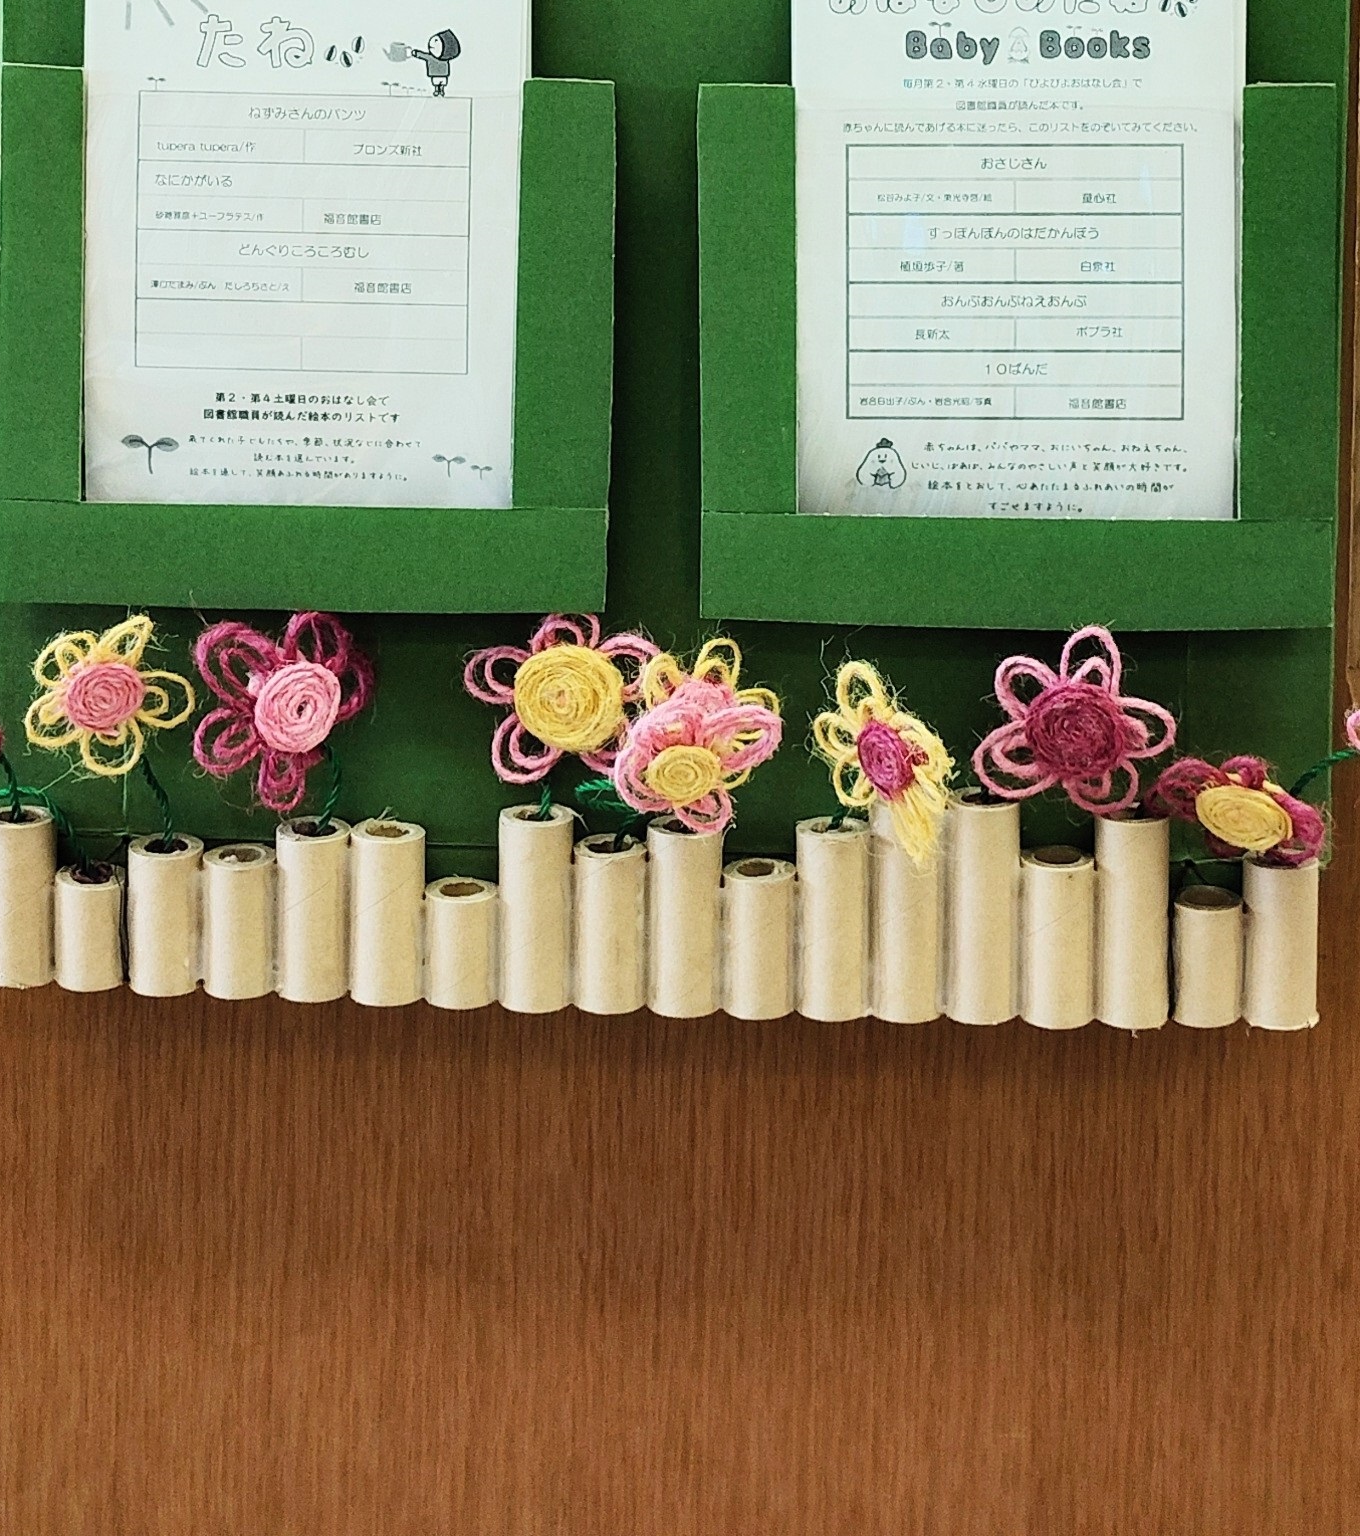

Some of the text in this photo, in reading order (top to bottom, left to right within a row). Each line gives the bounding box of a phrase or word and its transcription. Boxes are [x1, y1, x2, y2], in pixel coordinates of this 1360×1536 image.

[196, 14, 315, 69] たね
[905, 29, 1151, 65] Baby Books
[979, 156, 1048, 171] おさじさん
[154, 173, 234, 189] なにかがいる
